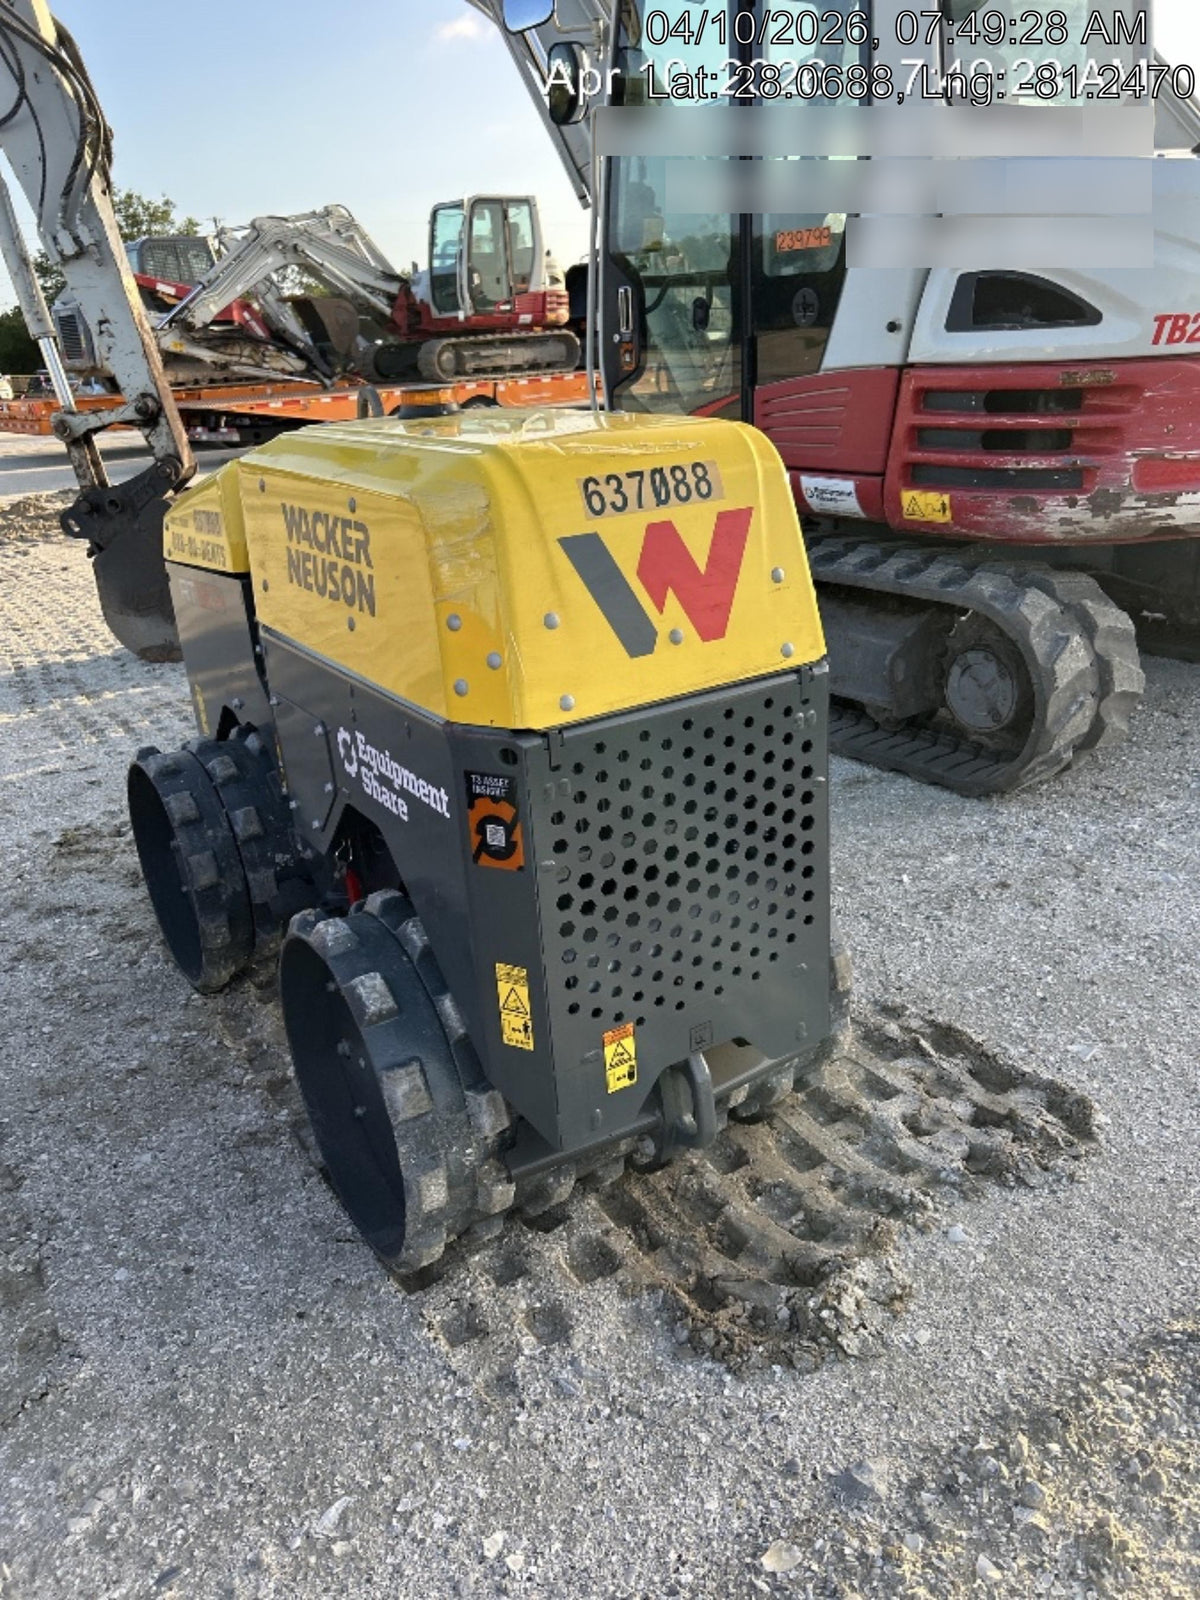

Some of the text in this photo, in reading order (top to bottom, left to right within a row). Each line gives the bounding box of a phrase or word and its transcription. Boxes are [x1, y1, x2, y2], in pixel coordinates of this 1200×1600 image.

[777, 227, 831, 250] 239799
[281, 502, 374, 569] WACKER
[286, 546, 376, 617] NEUSON
[355, 730, 450, 818] Equipment
[361, 767, 409, 822] Share
